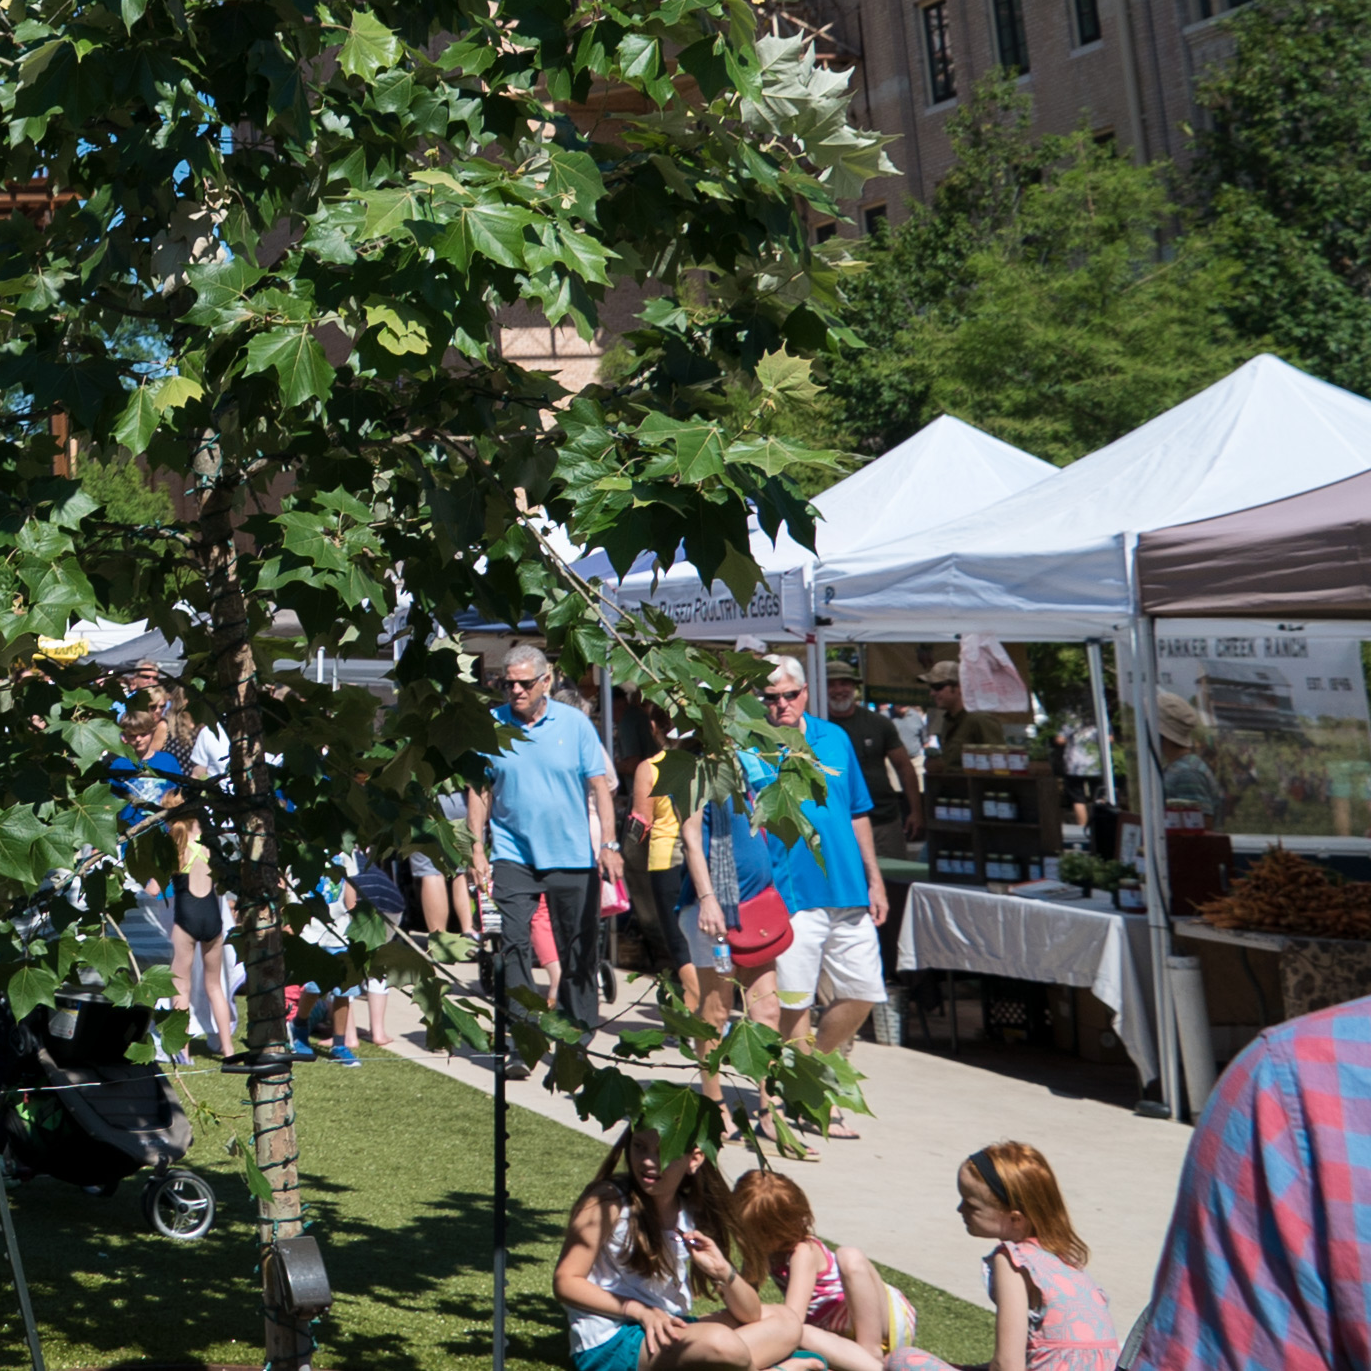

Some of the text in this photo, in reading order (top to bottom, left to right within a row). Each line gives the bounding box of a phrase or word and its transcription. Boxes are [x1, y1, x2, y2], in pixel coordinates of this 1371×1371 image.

[750, 592, 781, 618] EGGS
[1216, 637, 1257, 658] CREEK
[1264, 637, 1309, 658] RANCH
